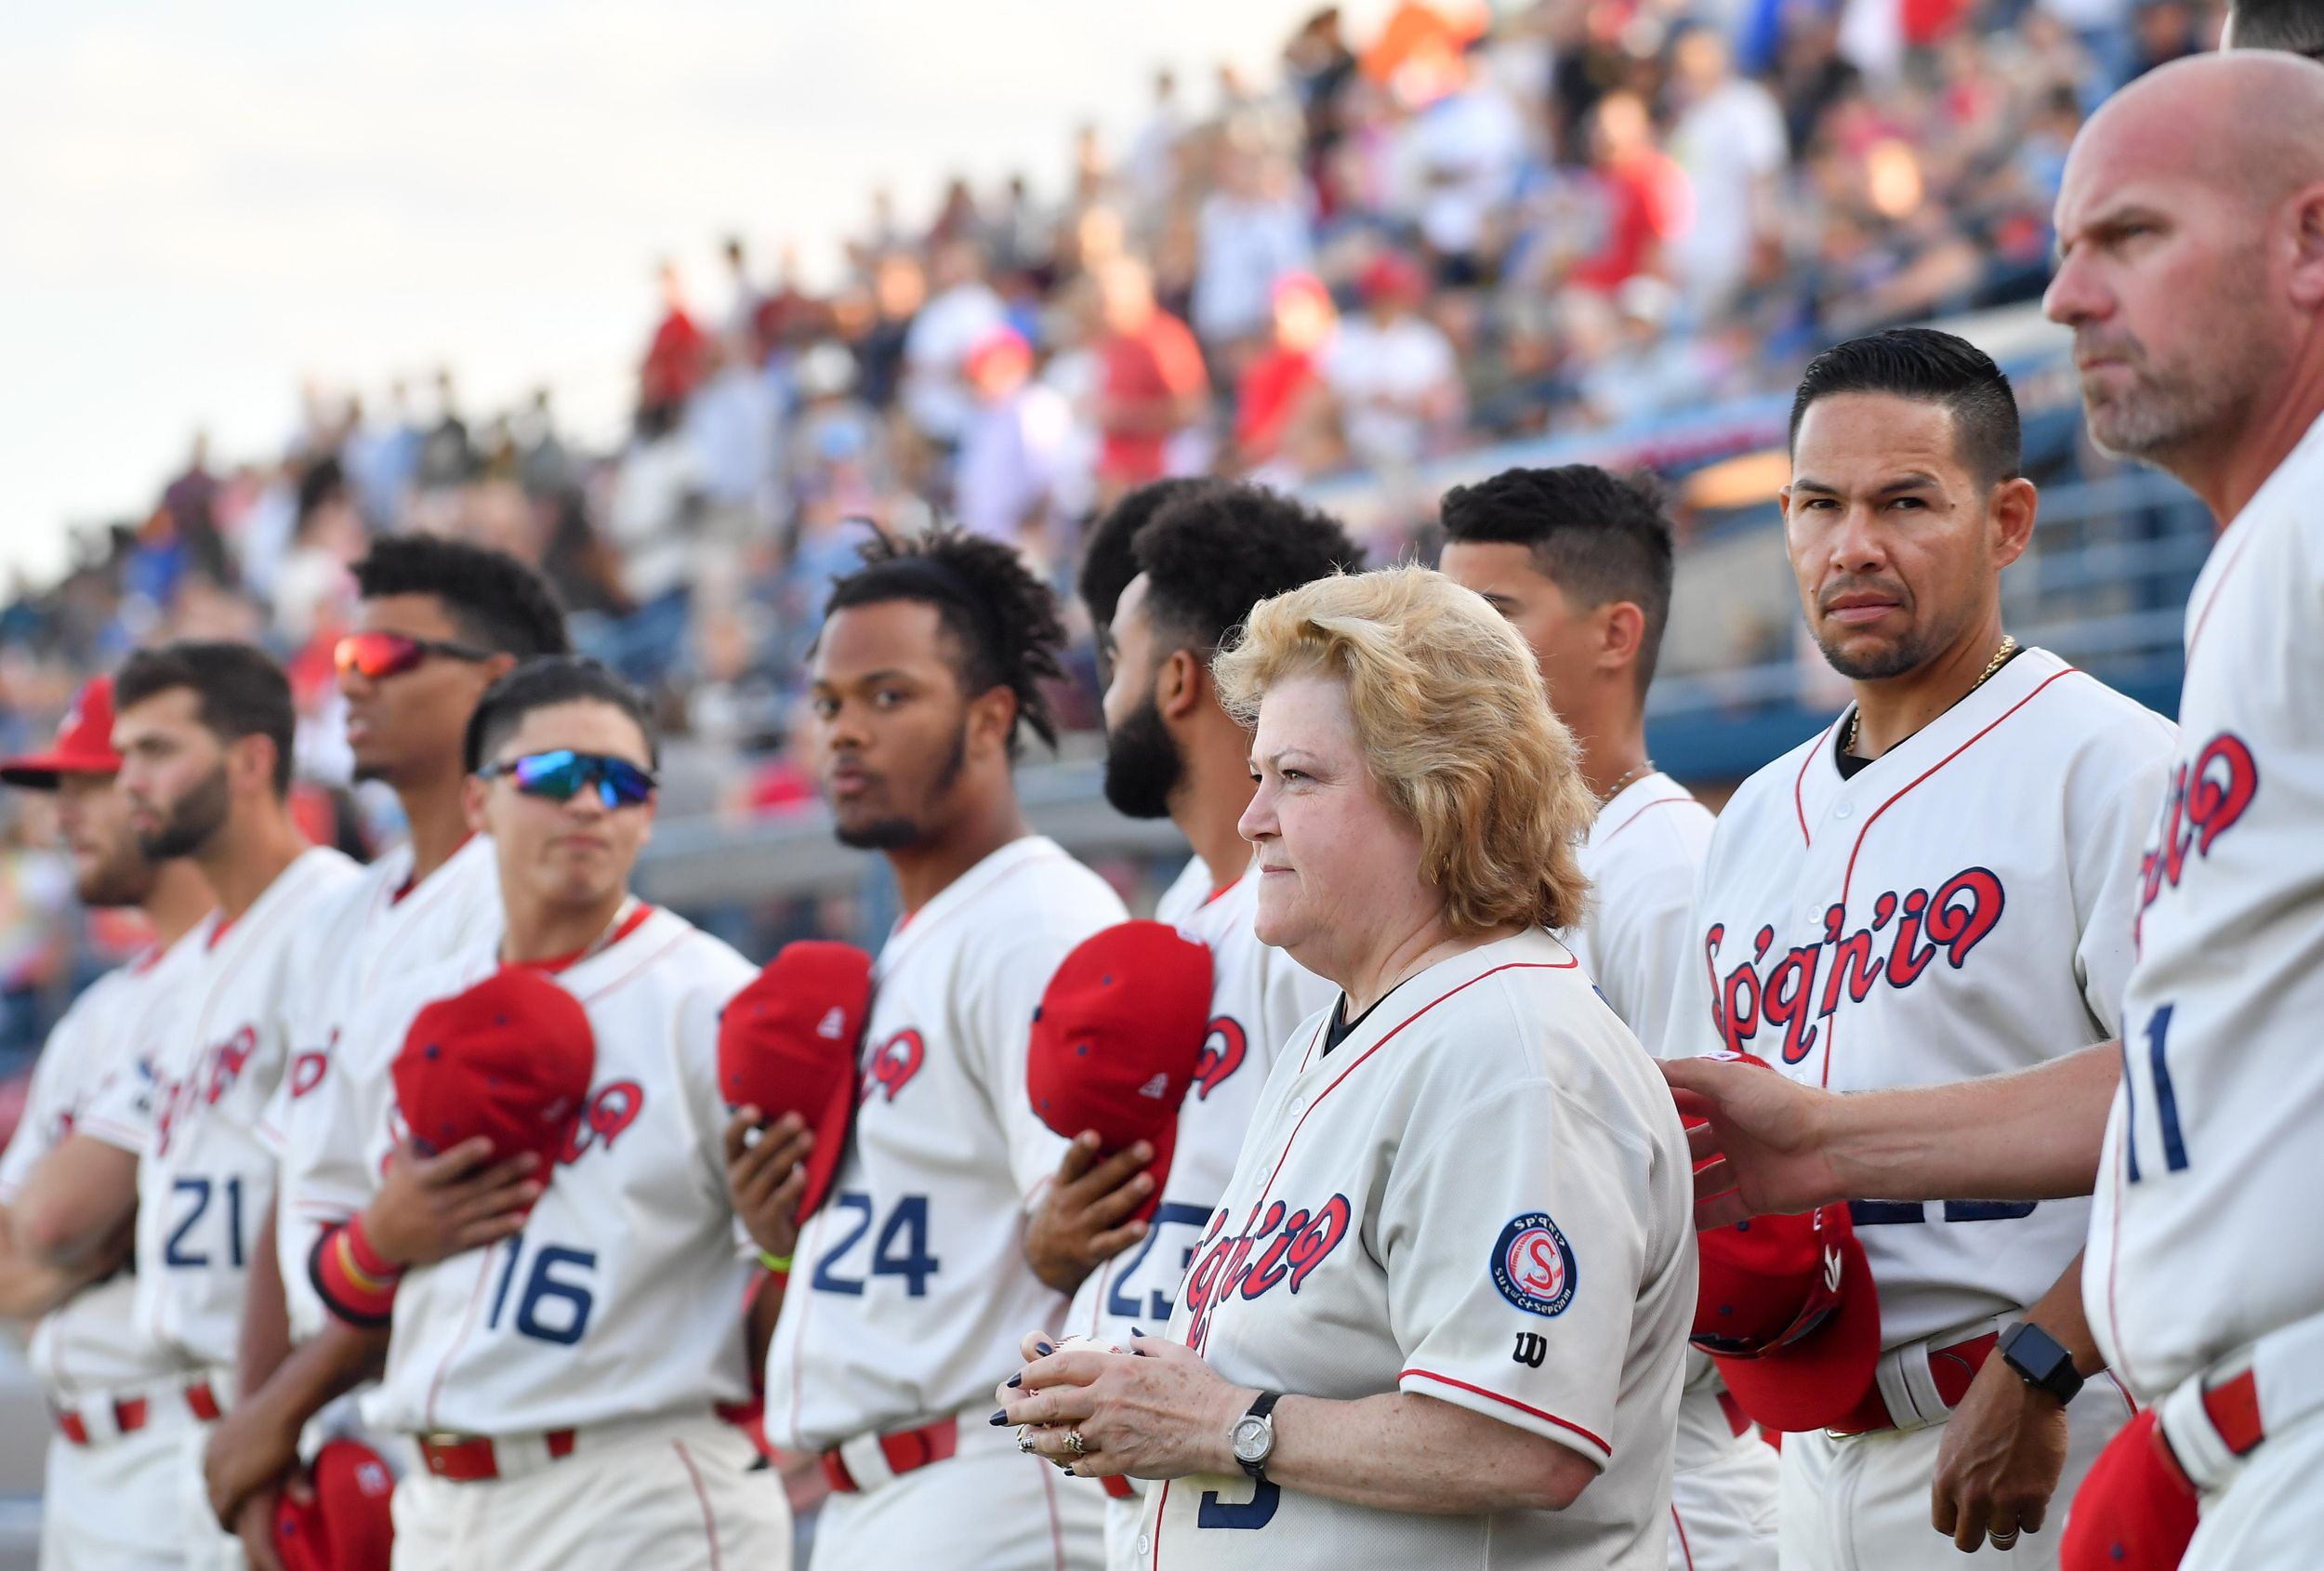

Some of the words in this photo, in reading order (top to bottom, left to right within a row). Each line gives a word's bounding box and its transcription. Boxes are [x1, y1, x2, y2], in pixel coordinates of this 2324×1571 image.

[165, 1176, 244, 1268] 21
[810, 1191, 940, 1298] 24
[488, 1233, 598, 1346] 16
